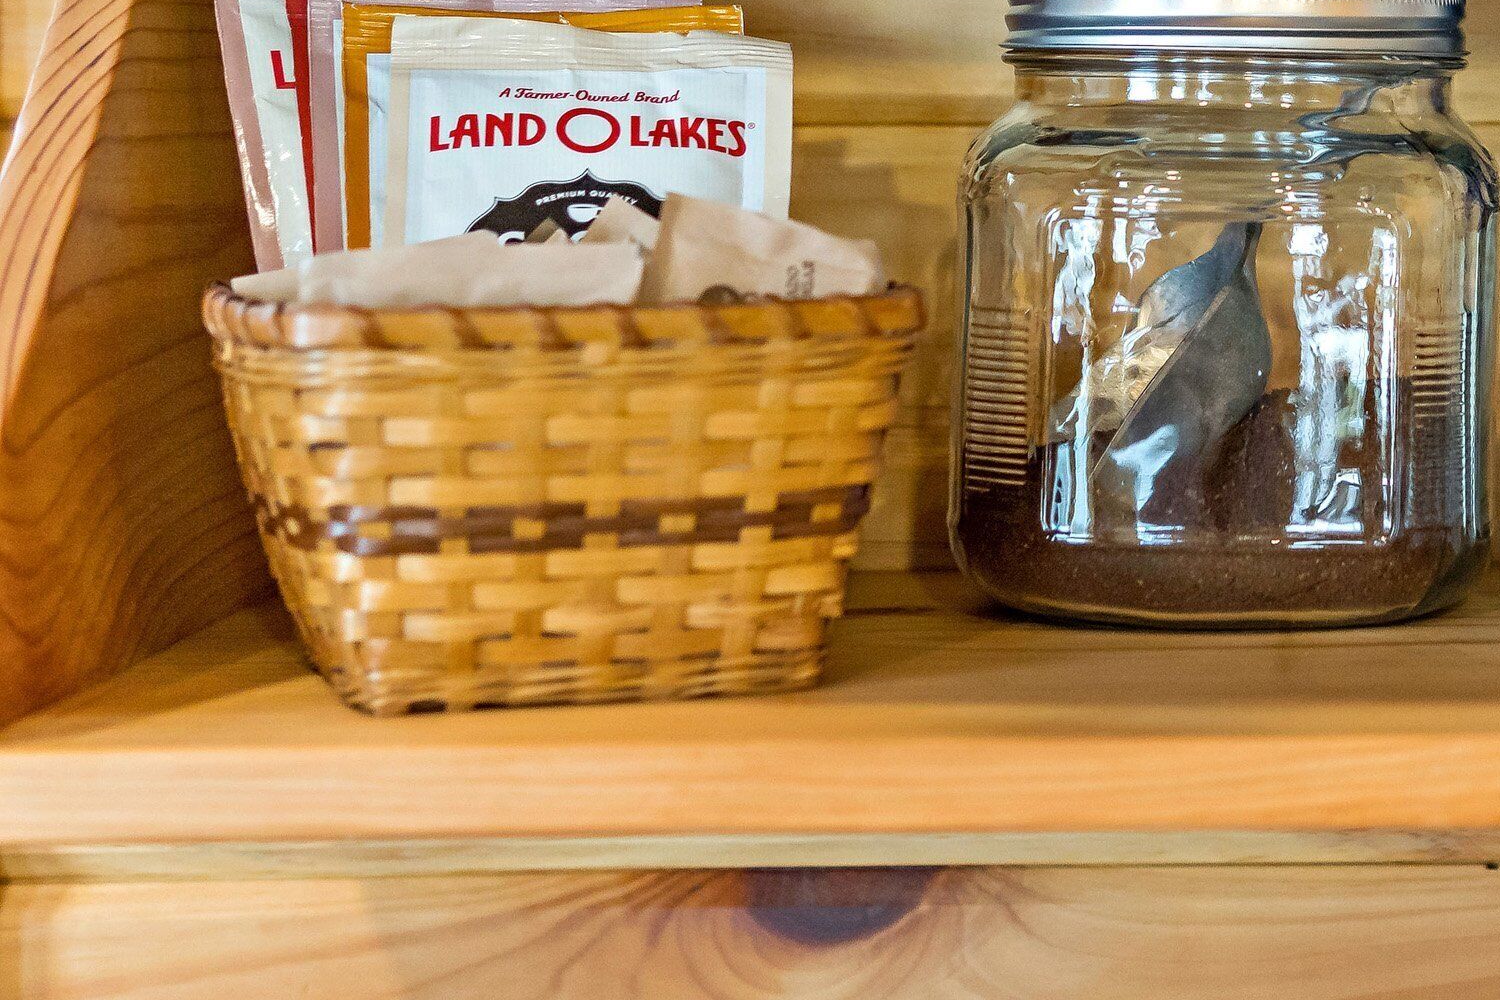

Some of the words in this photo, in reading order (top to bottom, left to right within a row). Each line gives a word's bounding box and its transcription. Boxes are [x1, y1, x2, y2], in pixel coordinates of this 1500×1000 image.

[499, 87, 511, 98] A
[514, 88, 630, 102] Farmer-Owned
[634, 90, 681, 104] Brand
[429, 113, 547, 152] LAND
[556, 107, 621, 154] O
[630, 115, 747, 157] LAKES
[535, 189, 586, 206] PREMIUM
